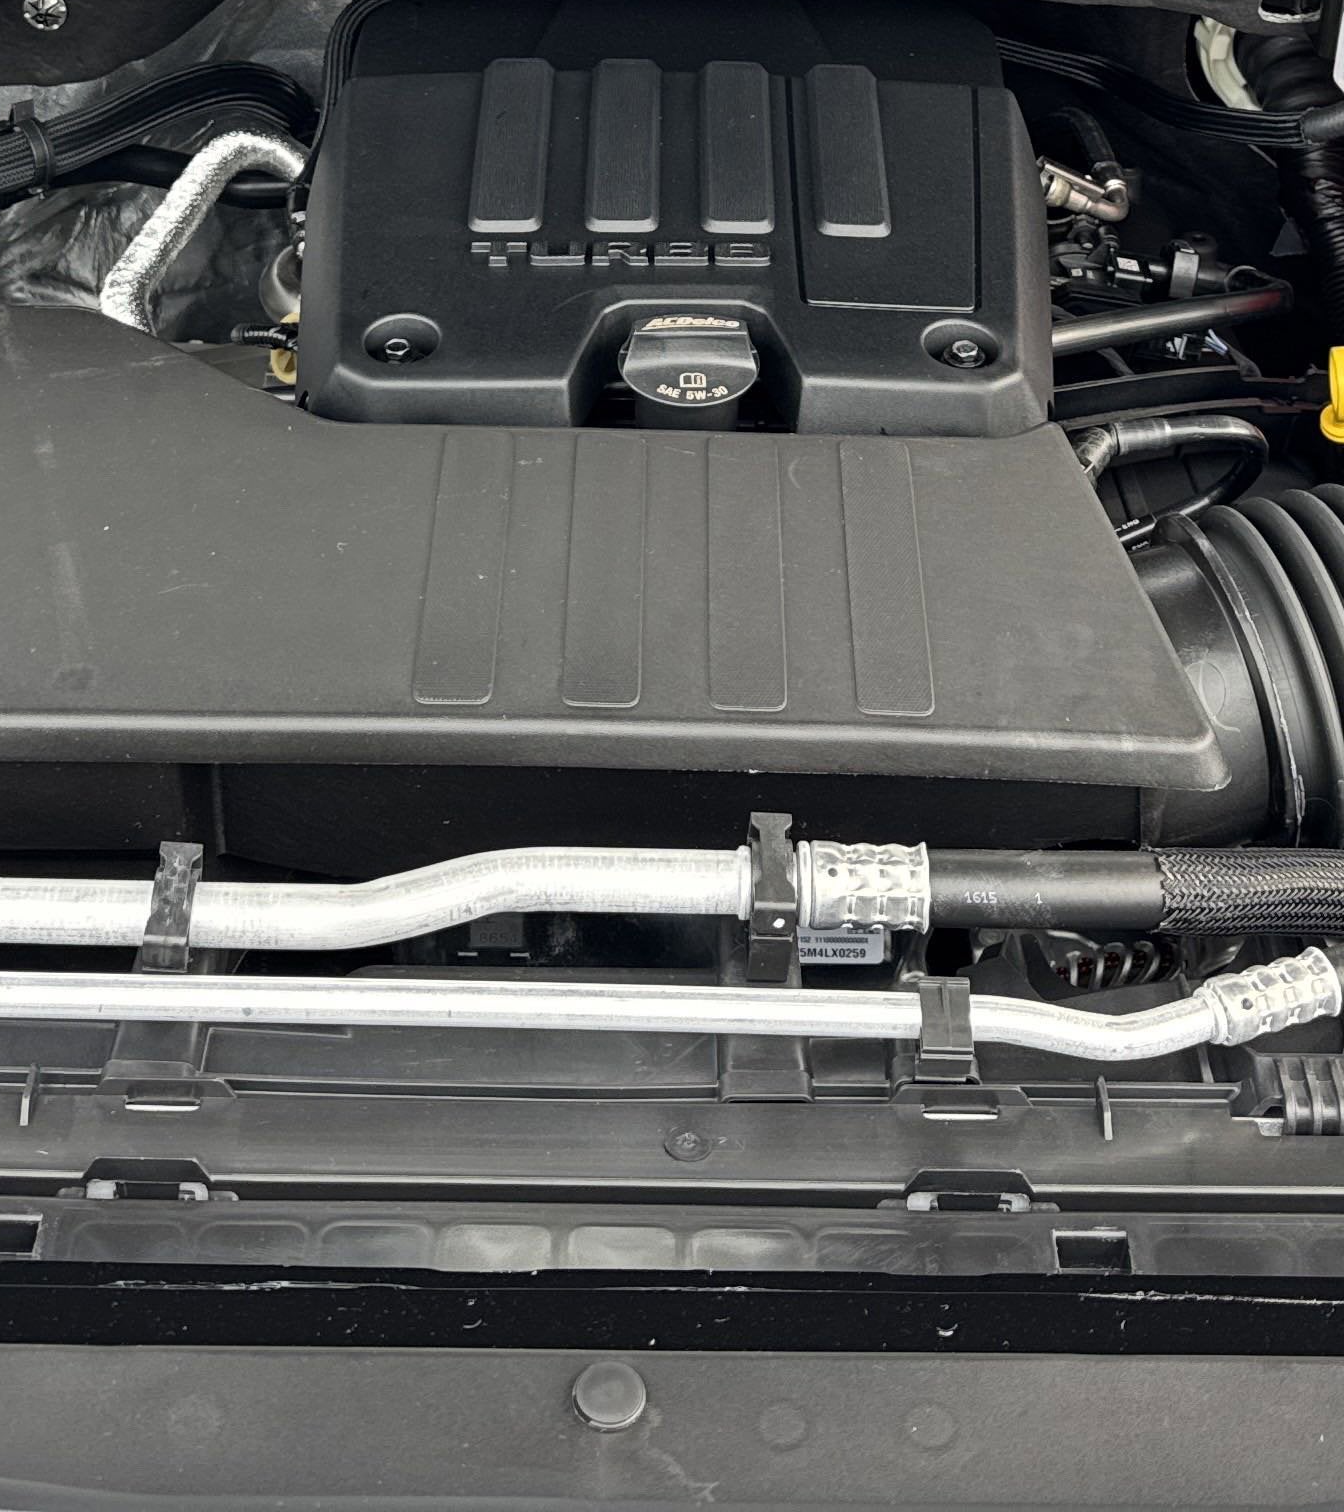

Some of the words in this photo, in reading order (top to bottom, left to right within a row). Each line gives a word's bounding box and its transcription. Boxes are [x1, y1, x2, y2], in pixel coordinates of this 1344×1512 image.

[470, 240, 772, 268] TURBO
[642, 316, 741, 331] ACDelco
[656, 383, 682, 399] SAE
[685, 385, 729, 401] 5W-30
[963, 890, 998, 904] 1615
[1034, 891, 1044, 905] 1
[799, 947, 867, 959] 5M4LX0259
